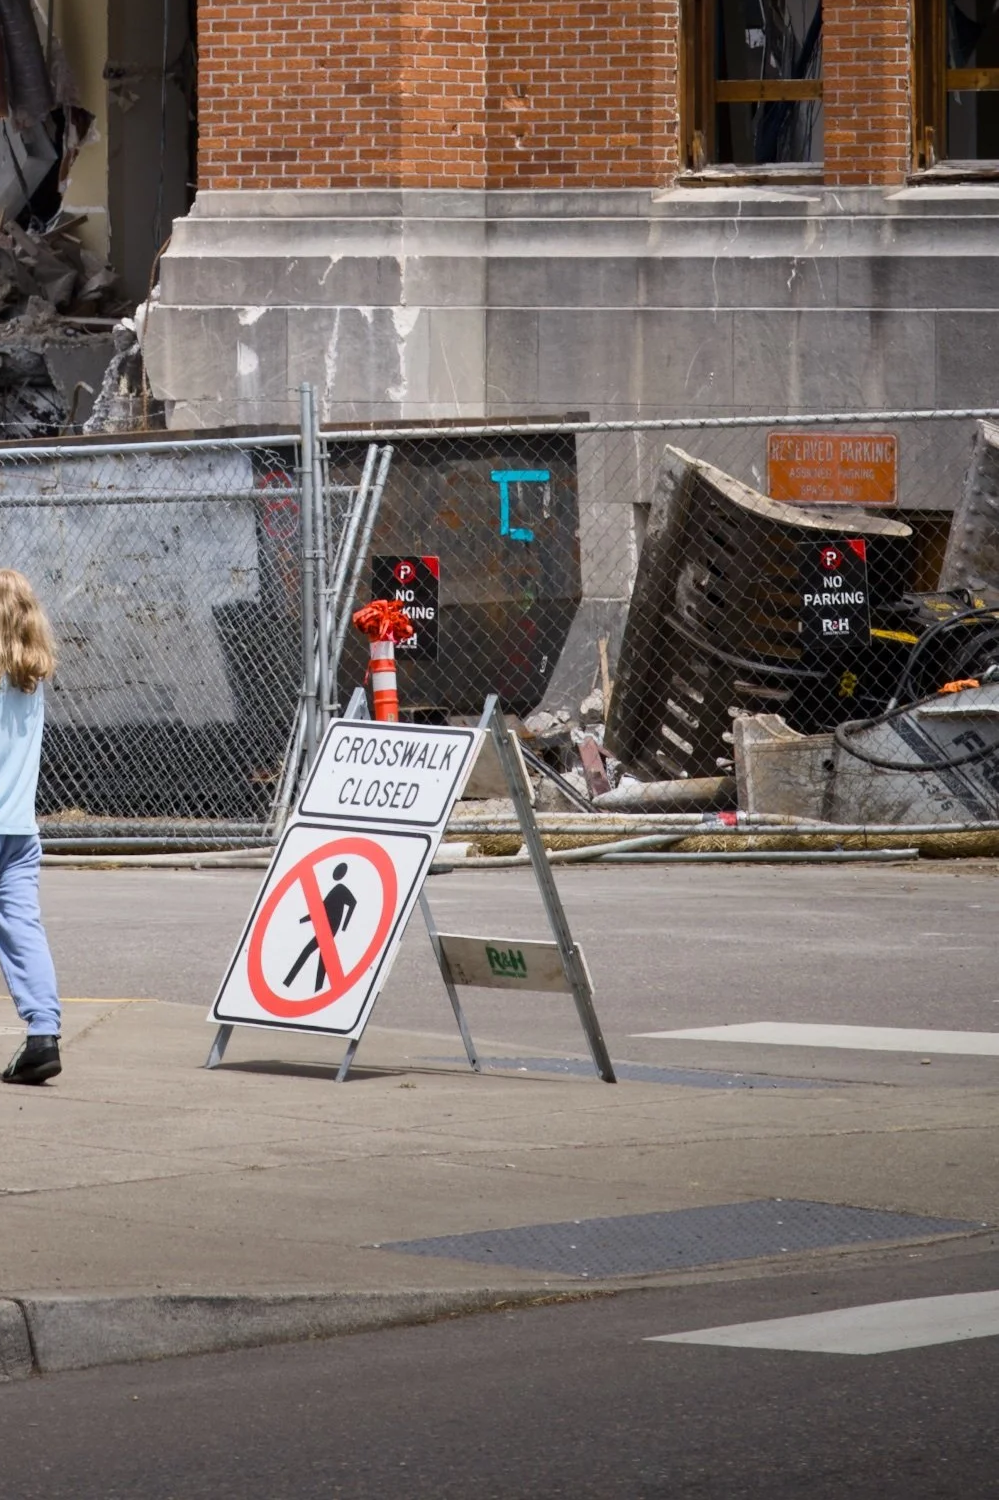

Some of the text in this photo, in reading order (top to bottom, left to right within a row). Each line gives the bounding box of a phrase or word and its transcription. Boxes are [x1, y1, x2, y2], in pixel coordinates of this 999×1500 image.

[771, 439, 892, 463] RESERVED PARKING
[823, 575, 843, 589] NO
[395, 589, 415, 602] NO
[803, 591, 865, 606] PARKING
[822, 618, 849, 632] R&H
[333, 735, 458, 771] CROSSWALK
[338, 777, 420, 809] CLOSED
[485, 946, 527, 972] R&H
